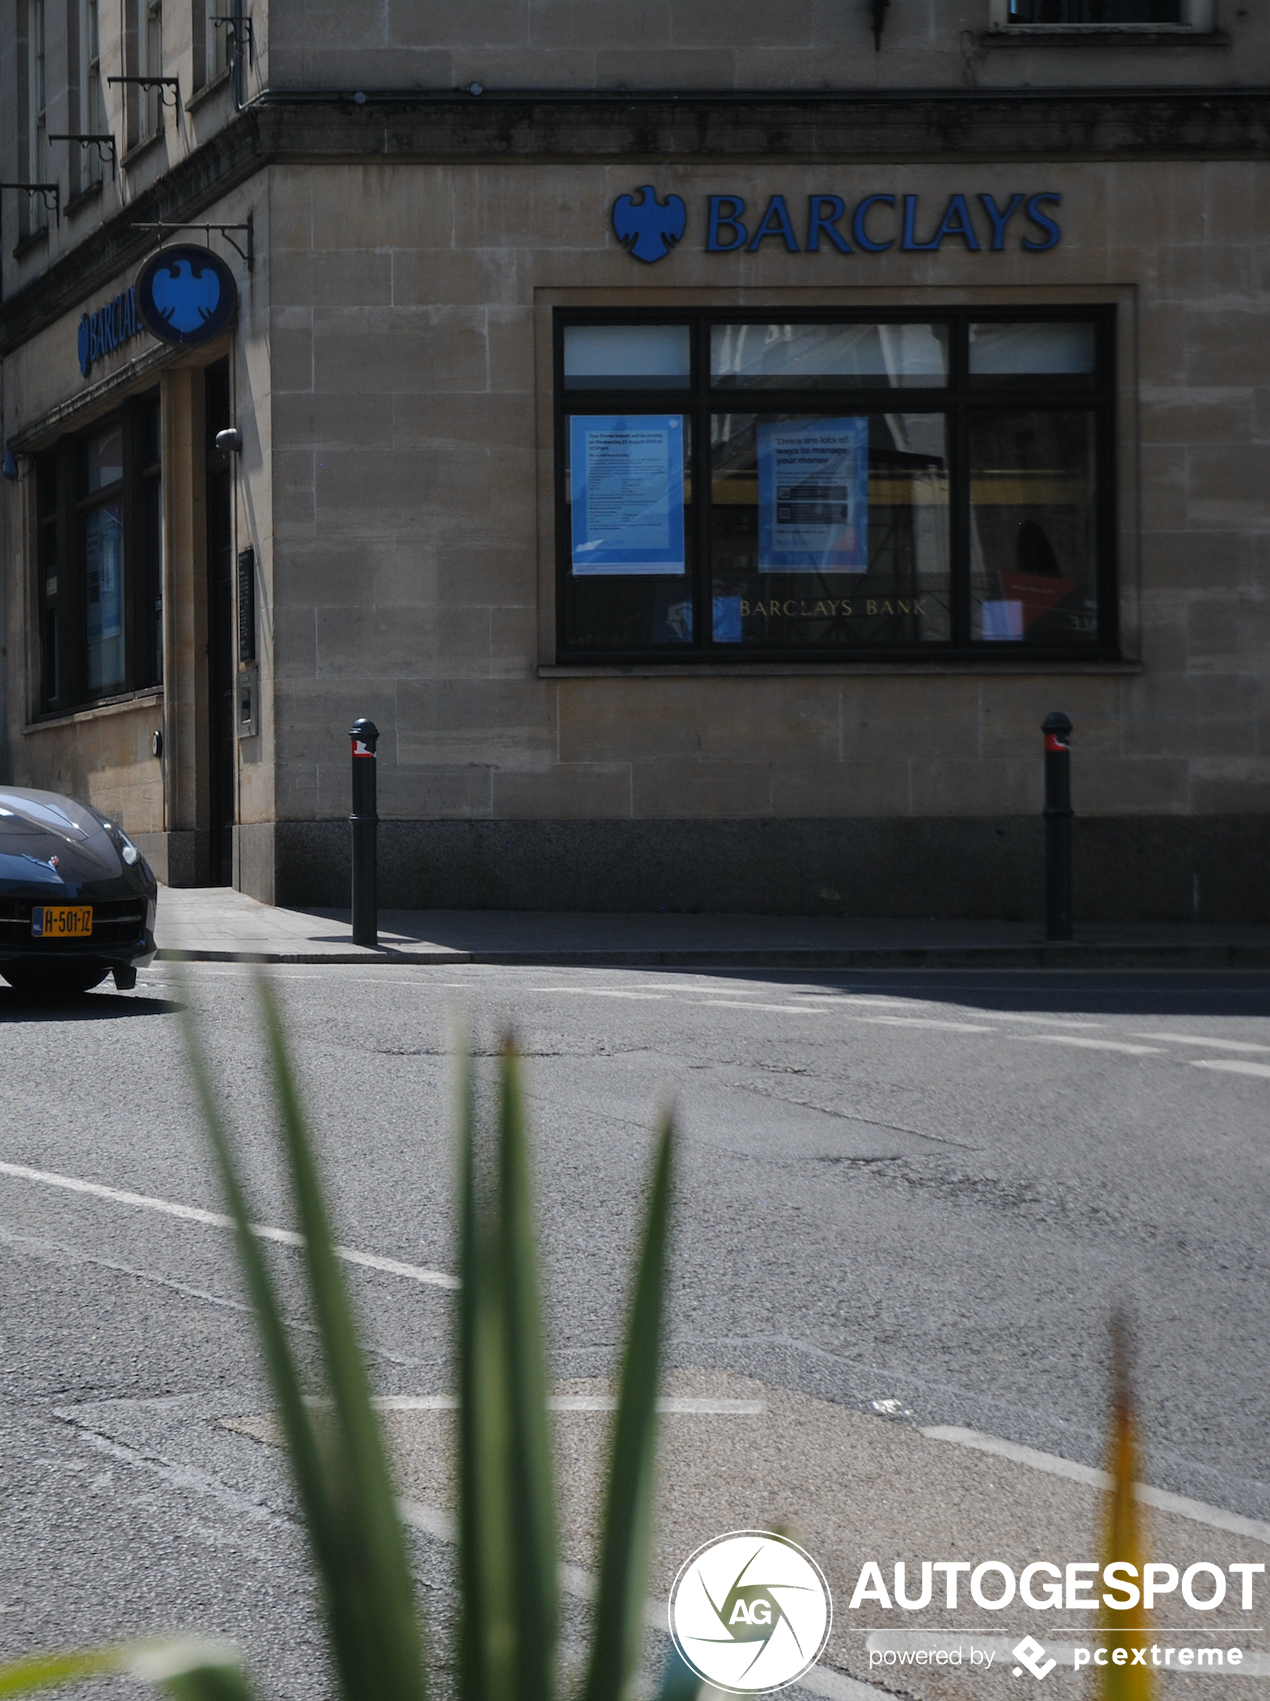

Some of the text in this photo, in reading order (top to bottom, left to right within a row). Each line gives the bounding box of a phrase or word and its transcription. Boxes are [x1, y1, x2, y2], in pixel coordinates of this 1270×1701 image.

[705, 191, 1063, 255] BARCLAYS
[90, 287, 142, 363] BARCLAY
[775, 437, 802, 445] There
[776, 448, 798, 456] ways
[811, 447, 847, 456] manage
[776, 457, 828, 466] your money
[739, 599, 927, 617] BARCLAYS BANK
[45, 911, 91, 933] H-501-JZ
